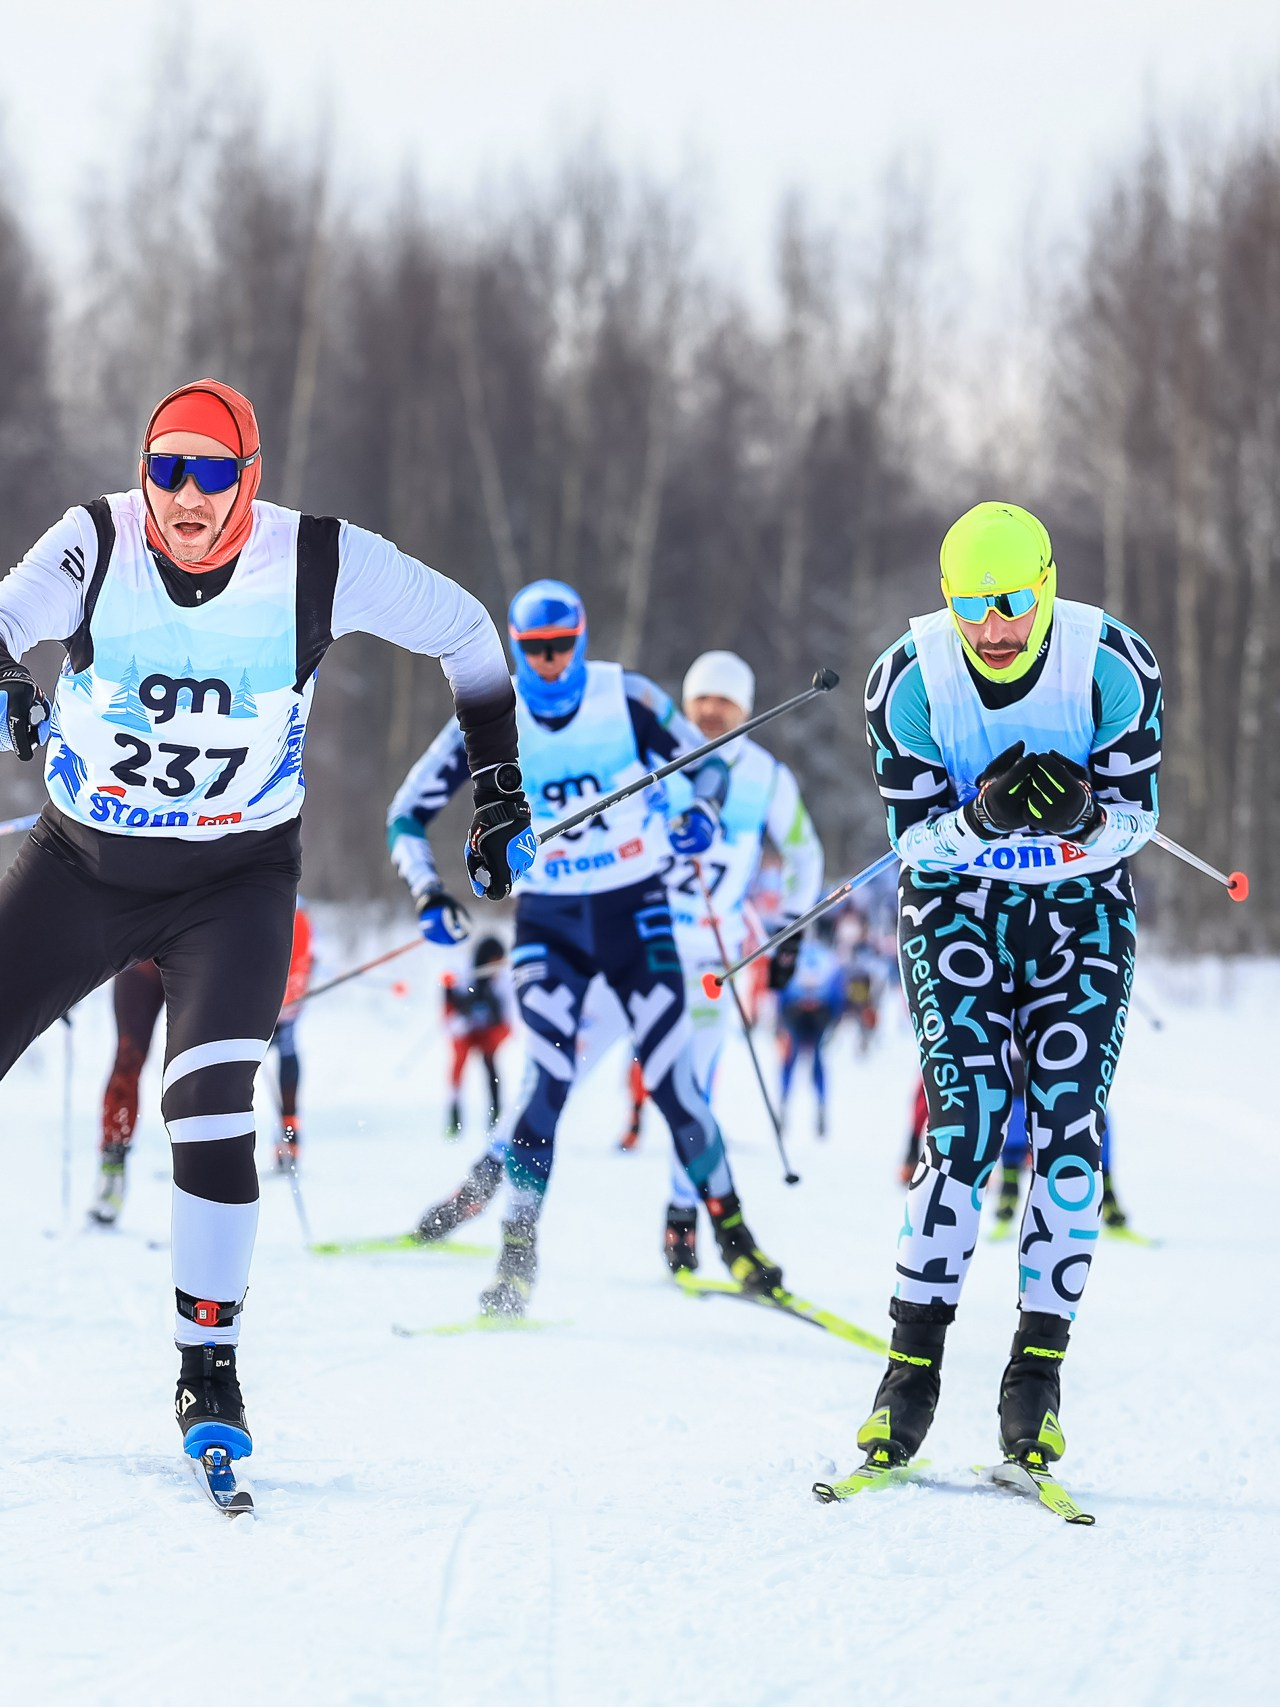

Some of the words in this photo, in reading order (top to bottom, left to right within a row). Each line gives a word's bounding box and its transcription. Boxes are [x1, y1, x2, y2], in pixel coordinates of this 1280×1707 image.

[138, 673, 231, 724] gm
[110, 733, 249, 799] 237
[542, 773, 602, 810] gm
